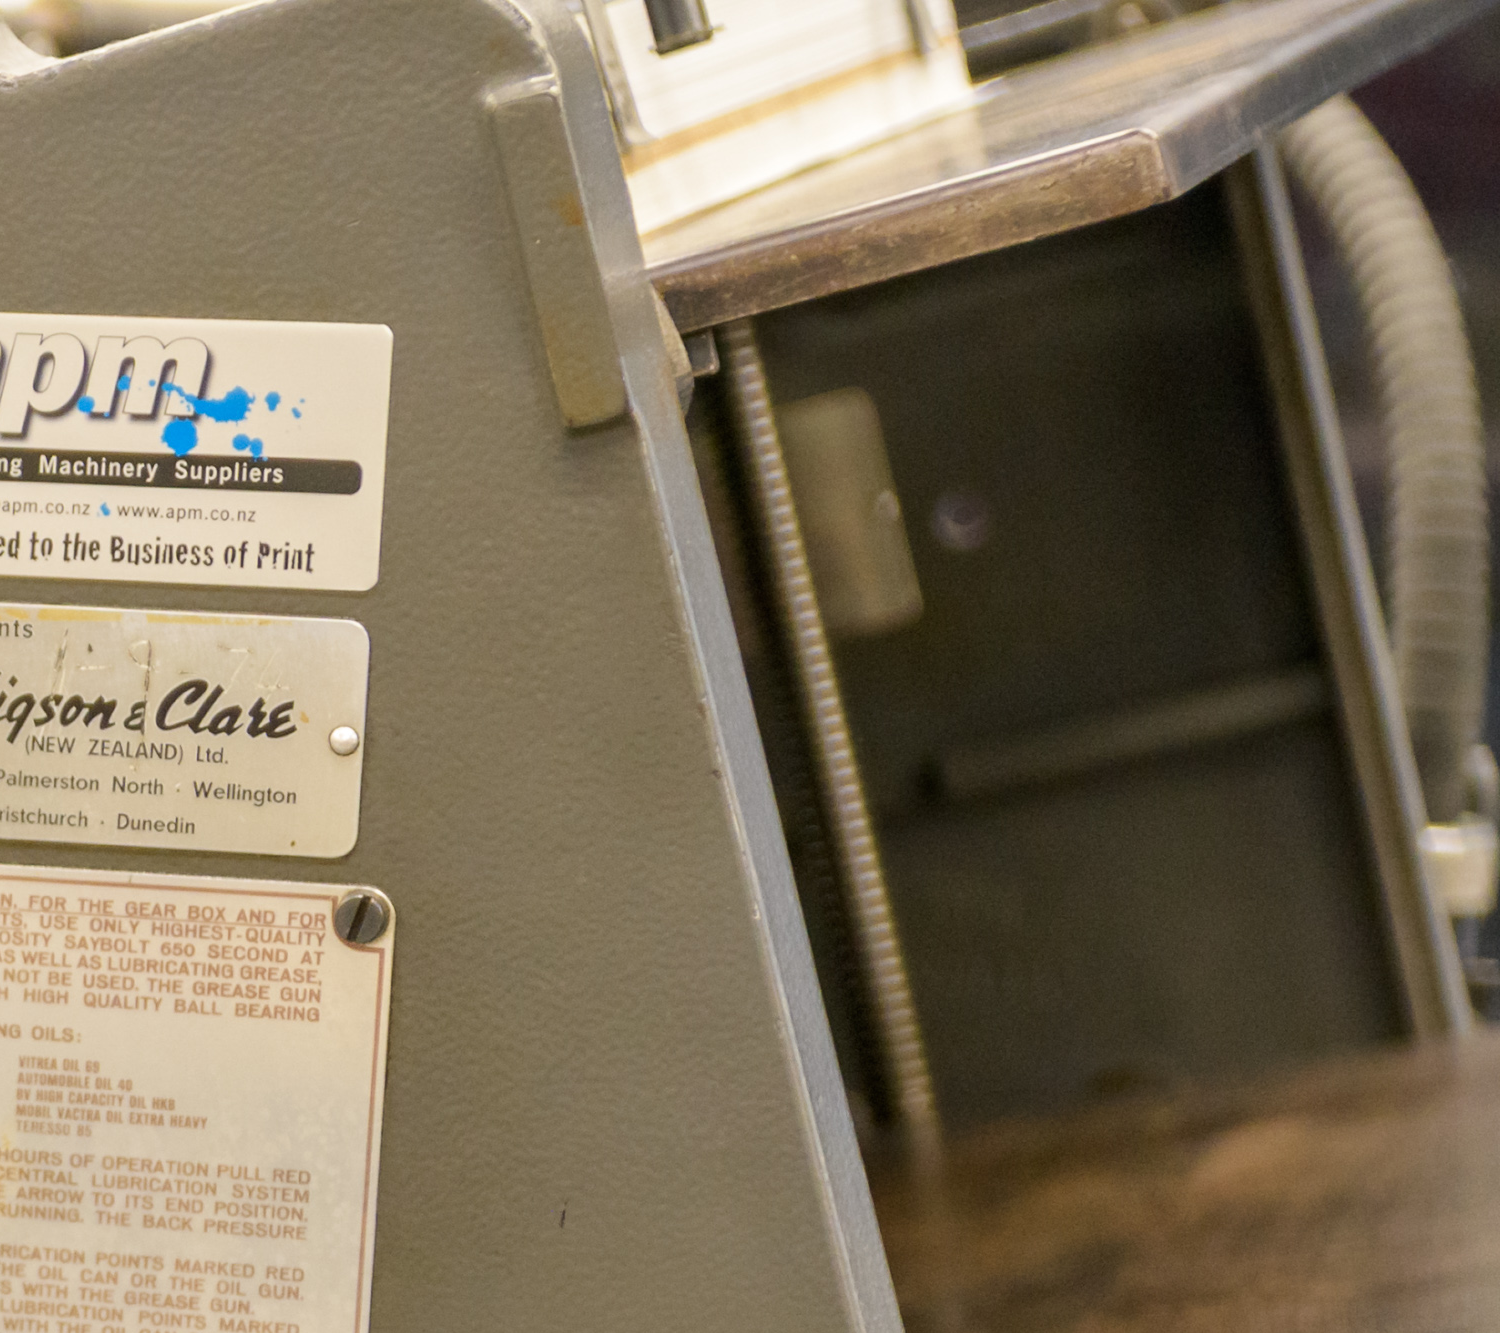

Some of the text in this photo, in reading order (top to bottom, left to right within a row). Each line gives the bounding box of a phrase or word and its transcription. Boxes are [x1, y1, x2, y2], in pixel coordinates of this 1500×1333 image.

[39, 455, 159, 481] Machinery
[175, 460, 285, 485] Suppliers
[116, 504, 257, 524] www.apm.co.nz
[30, 531, 53, 561] to
[62, 532, 101, 562] the
[110, 536, 214, 567] Business
[223, 541, 248, 570] of
[257, 541, 315, 573] Print
[155, 679, 298, 739] Clare
[25, 735, 230, 766] (NEW ZEALAND) Ltd.
[112, 776, 165, 796] North
[193, 781, 298, 808] Wellington
[116, 813, 196, 835] Dunedin
[28, 894, 67, 911] FOR
[77, 897, 114, 914] THE
[124, 900, 176, 918] GEAR
[187, 904, 225, 921] BOX
[236, 907, 276, 924] AND
[287, 910, 326, 927] FOR
[39, 914, 78, 931] USE
[89, 917, 139, 935] ONLY
[64, 934, 150, 954] SAYBOLT
[160, 940, 196, 957] 650
[207, 943, 288, 963] SECOND
[299, 949, 324, 965] AT
[21, 949, 72, 968] WELL
[76, 953, 102, 970] AS
[107, 955, 234, 978] LUBRICATING
[239, 963, 323, 984] GREASE,
[2, 967, 40, 985] NOT
[47, 970, 72, 987] BE
[146, 976, 183, 994] THE
[191, 979, 270, 999] GREASE
[279, 985, 321, 1003] GUN
[22, 987, 69, 1005] HIGH
[82, 990, 162, 1012] QUALITY
[173, 996, 222, 1015] BALL
[234, 1000, 320, 1022] BEARING
[30, 1024, 82, 1042] OILS:
